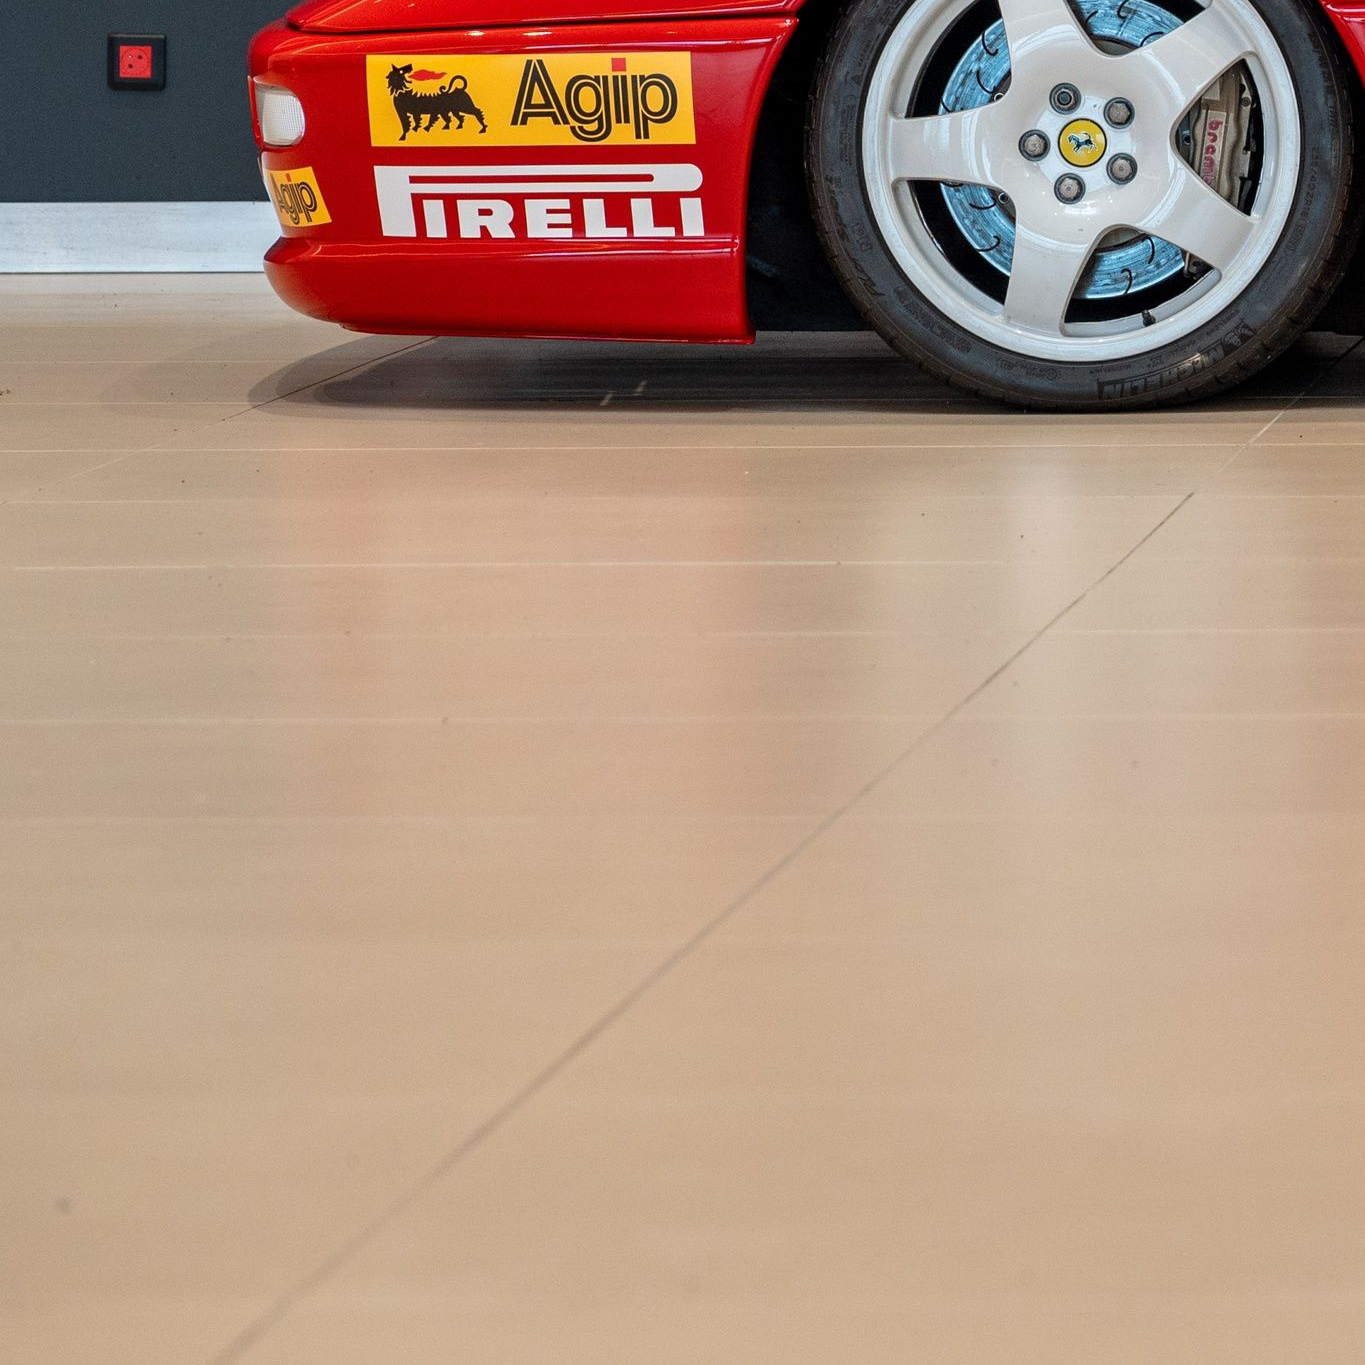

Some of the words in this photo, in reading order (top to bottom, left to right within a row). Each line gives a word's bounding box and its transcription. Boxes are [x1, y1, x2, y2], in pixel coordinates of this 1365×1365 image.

[510, 57, 679, 143] Agip
[1203, 120, 1223, 185] bremb
[269, 172, 318, 225] Agip
[373, 162, 704, 238] PIRELLI
